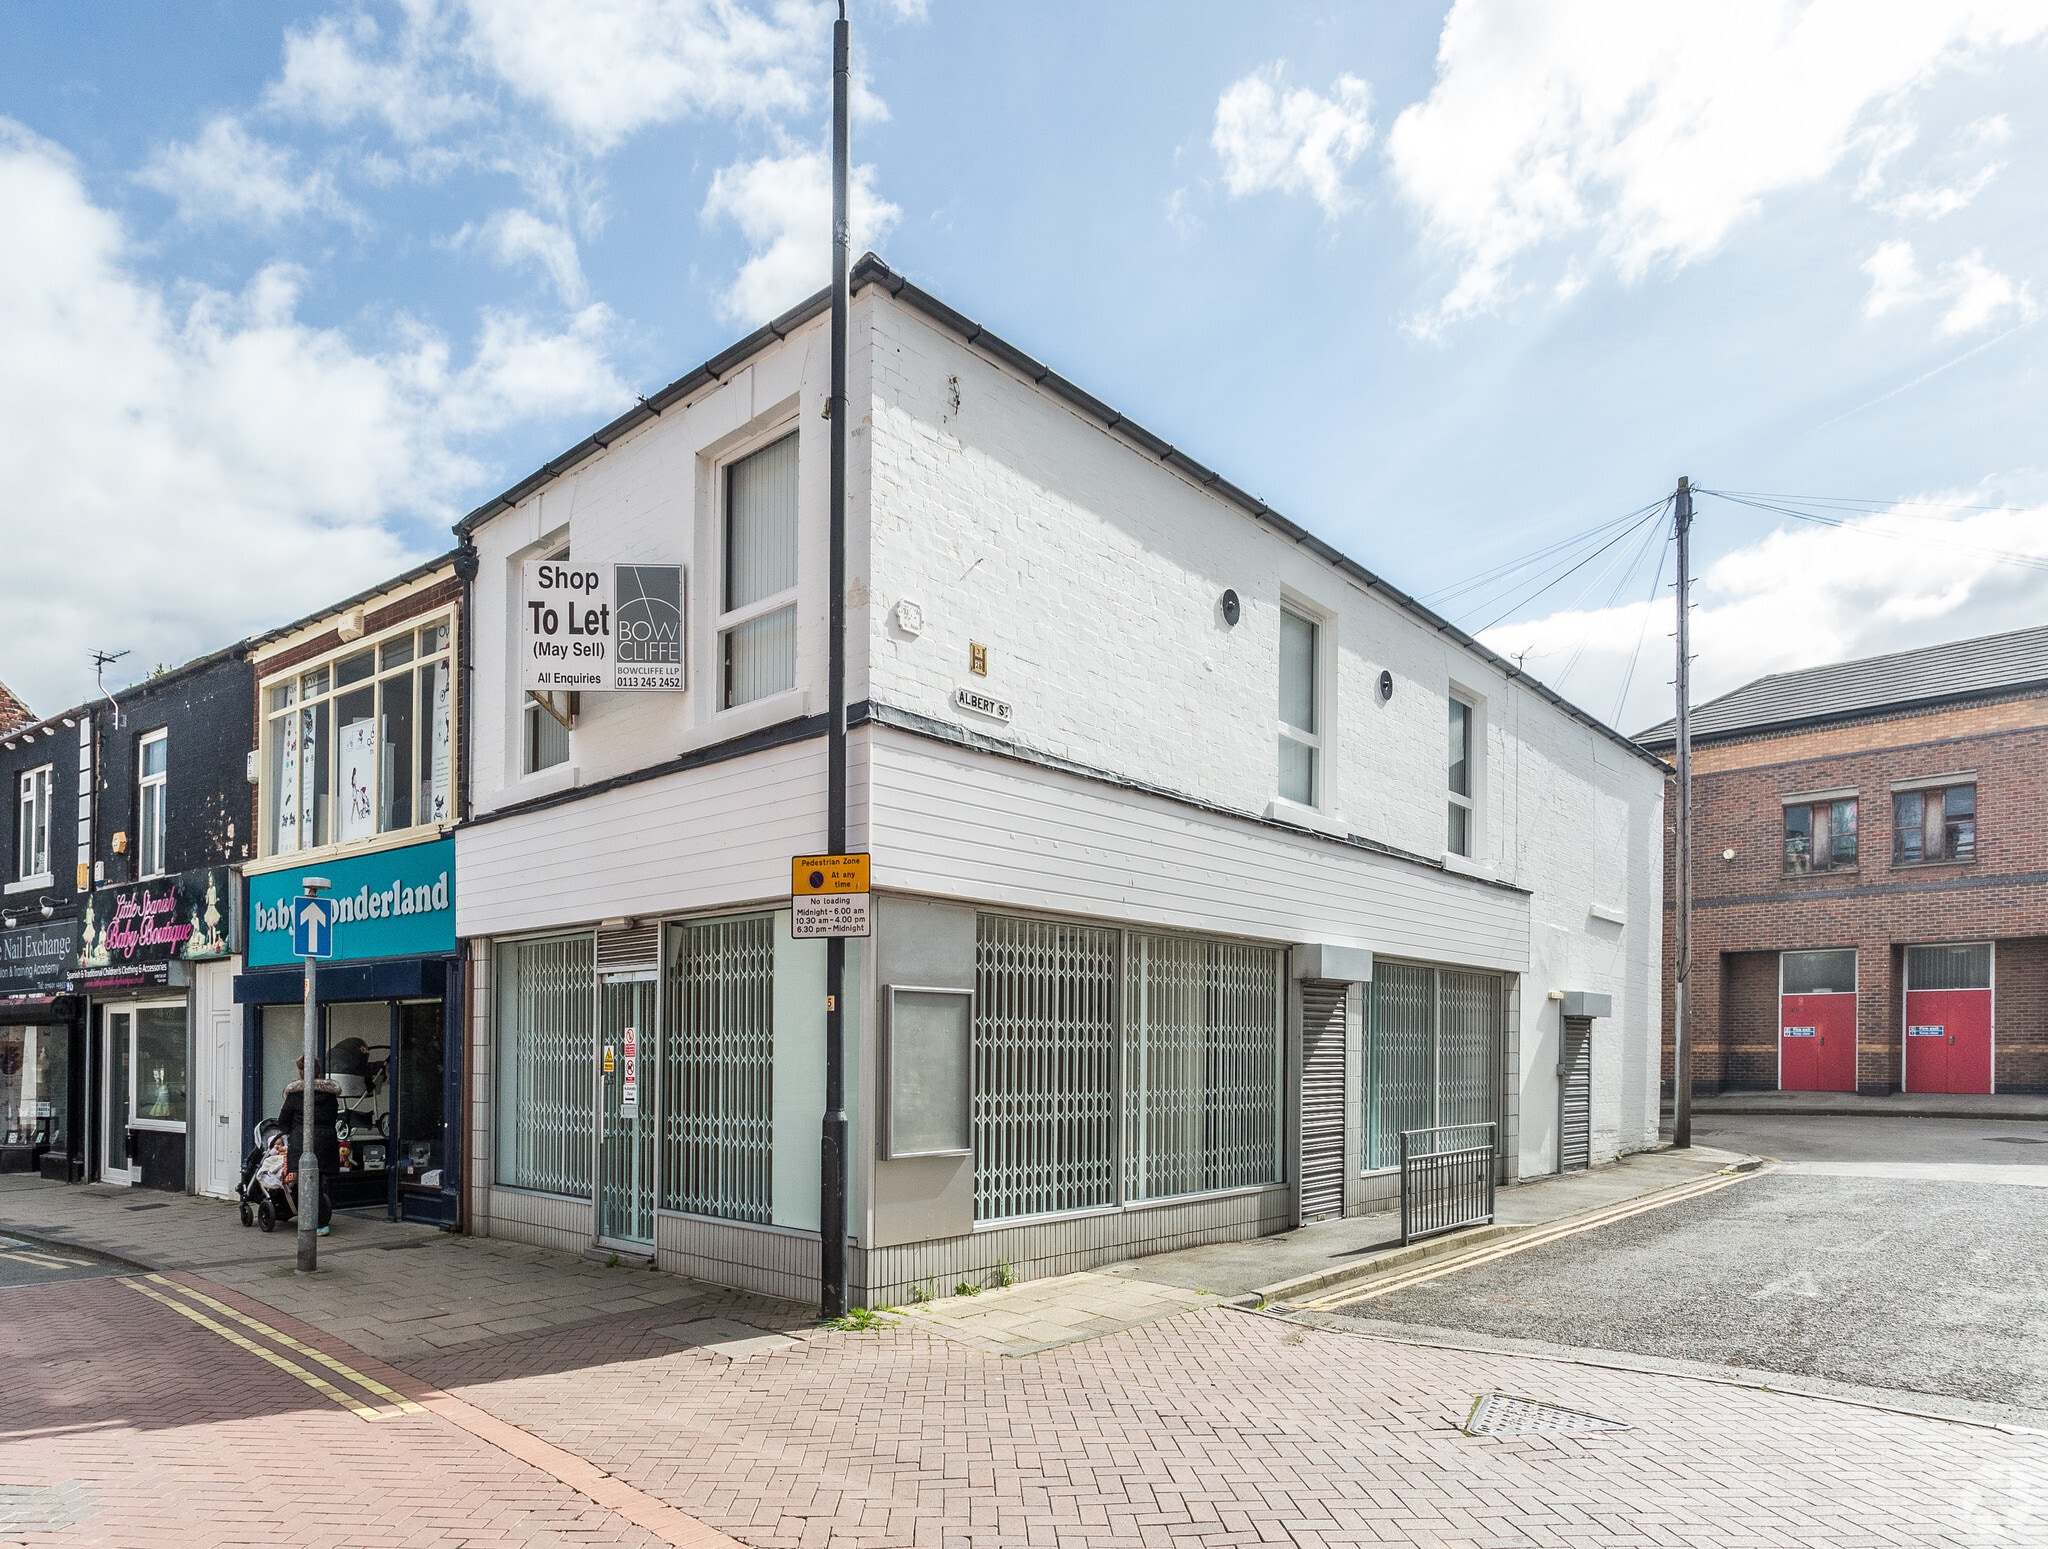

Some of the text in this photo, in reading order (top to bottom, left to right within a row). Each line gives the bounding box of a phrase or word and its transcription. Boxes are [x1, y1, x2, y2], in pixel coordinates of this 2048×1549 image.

[538, 566, 599, 595] Shop
[528, 601, 610, 636] To Let
[619, 620, 678, 641] BOW
[533, 642, 605, 660] (May Sell)
[618, 642, 678, 661] CLIFFE
[538, 673, 601, 686] All Enquiries
[617, 667, 680, 675] BOWCLIFFE LLP
[617, 678, 680, 688] 0113 245 2452
[959, 691, 995, 713] ALBERT
[802, 859, 840, 867] Pedestrian
[114, 885, 177, 922] Little Spanish
[331, 871, 449, 925] onderland
[824, 897, 851, 905] loading
[796, 917, 816, 925] 10.30
[818, 916, 829, 924] am
[835, 916, 852, 924] 4.00
[855, 916, 866, 924] pm
[797, 908, 828, 916] Midnight
[834, 907, 851, 915] 6.00
[105, 912, 193, 959] Baby Boutique
[816, 925, 827, 934] pm
[833, 924, 865, 933] Midnight
[4, 936, 22, 960] Nail
[25, 933, 71, 960] Exchange
[14, 965, 33, 979] Training
[34, 963, 60, 976] Academy
[67, 970, 81, 980] Spanish
[84, 968, 103, 978] Traditional
[103, 965, 121, 976] Children's
[122, 963, 139, 975] Clothing
[143, 961, 167, 972] Accessories
